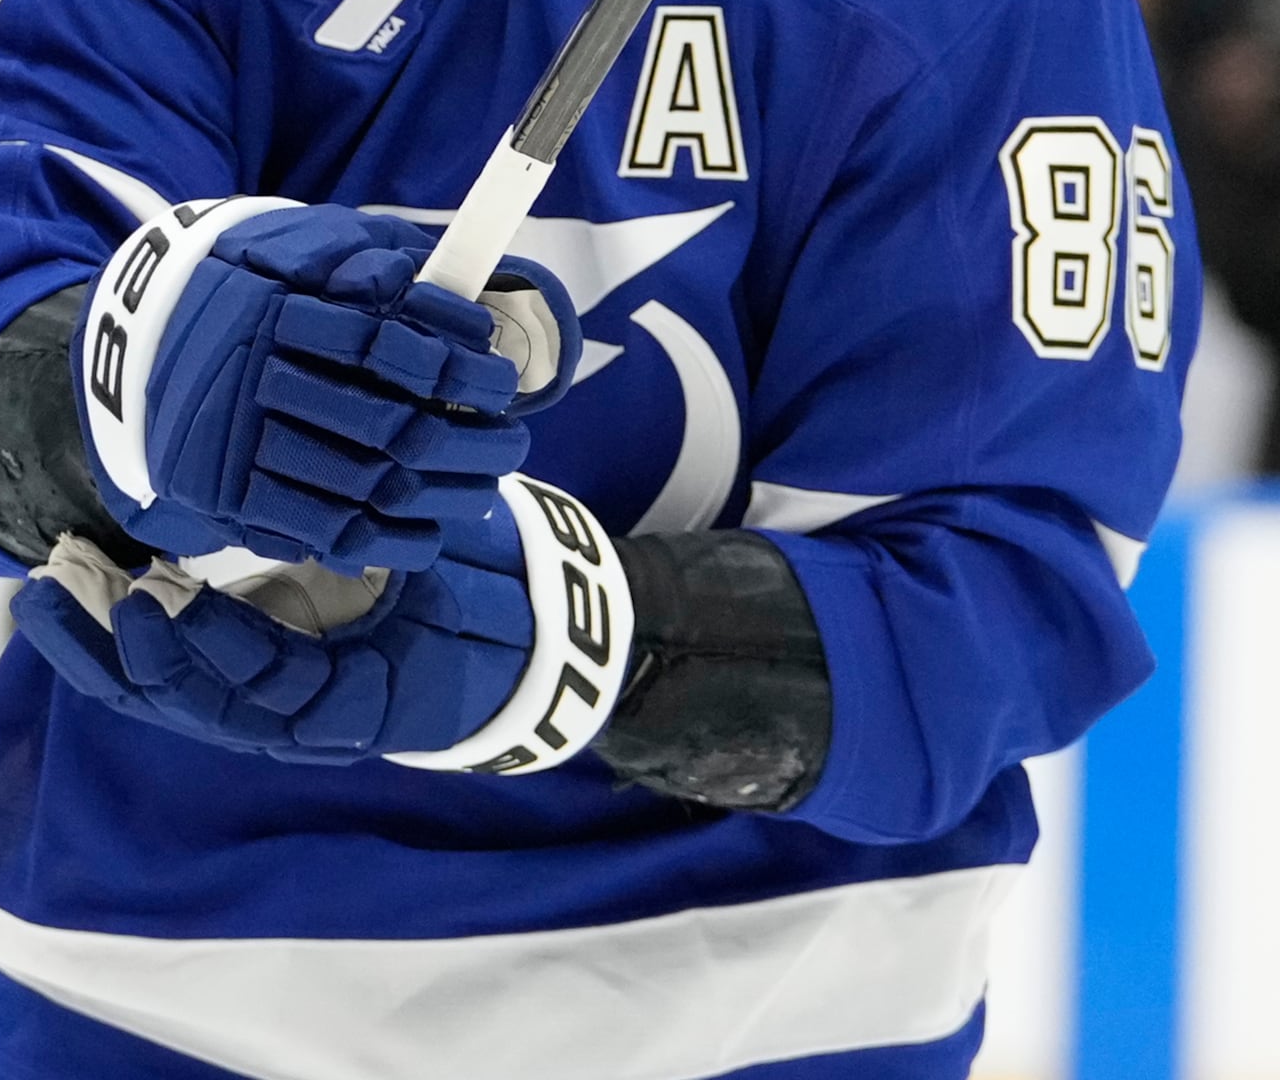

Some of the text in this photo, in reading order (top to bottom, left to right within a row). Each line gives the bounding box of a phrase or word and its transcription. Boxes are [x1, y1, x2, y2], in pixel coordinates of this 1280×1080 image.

[365, 15, 407, 54] YMCA
[617, 6, 749, 181] A
[998, 116, 1176, 372] 86
